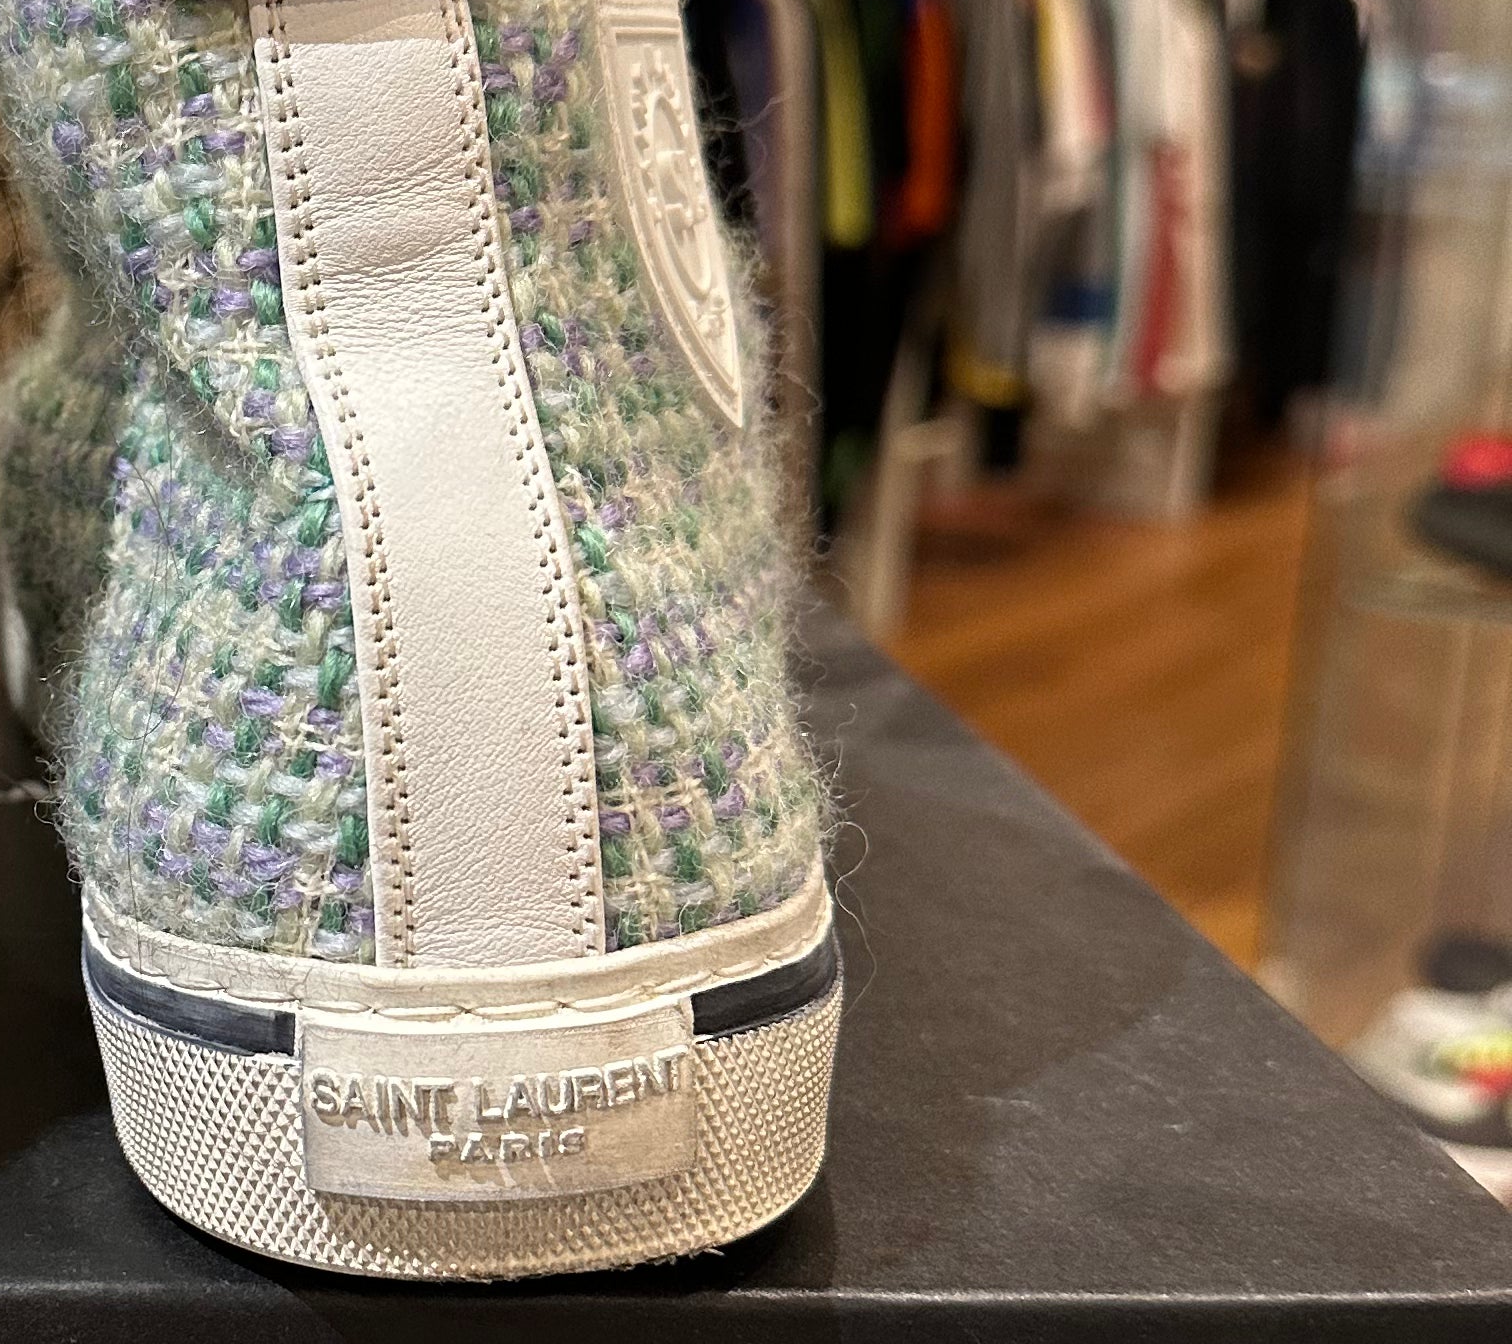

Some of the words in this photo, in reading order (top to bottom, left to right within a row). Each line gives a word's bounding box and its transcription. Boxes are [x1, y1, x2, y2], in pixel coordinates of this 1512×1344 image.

[309, 1067, 456, 1132] SAINT
[471, 1045, 688, 1124] LAURENT
[428, 1125, 585, 1163] PARIS
